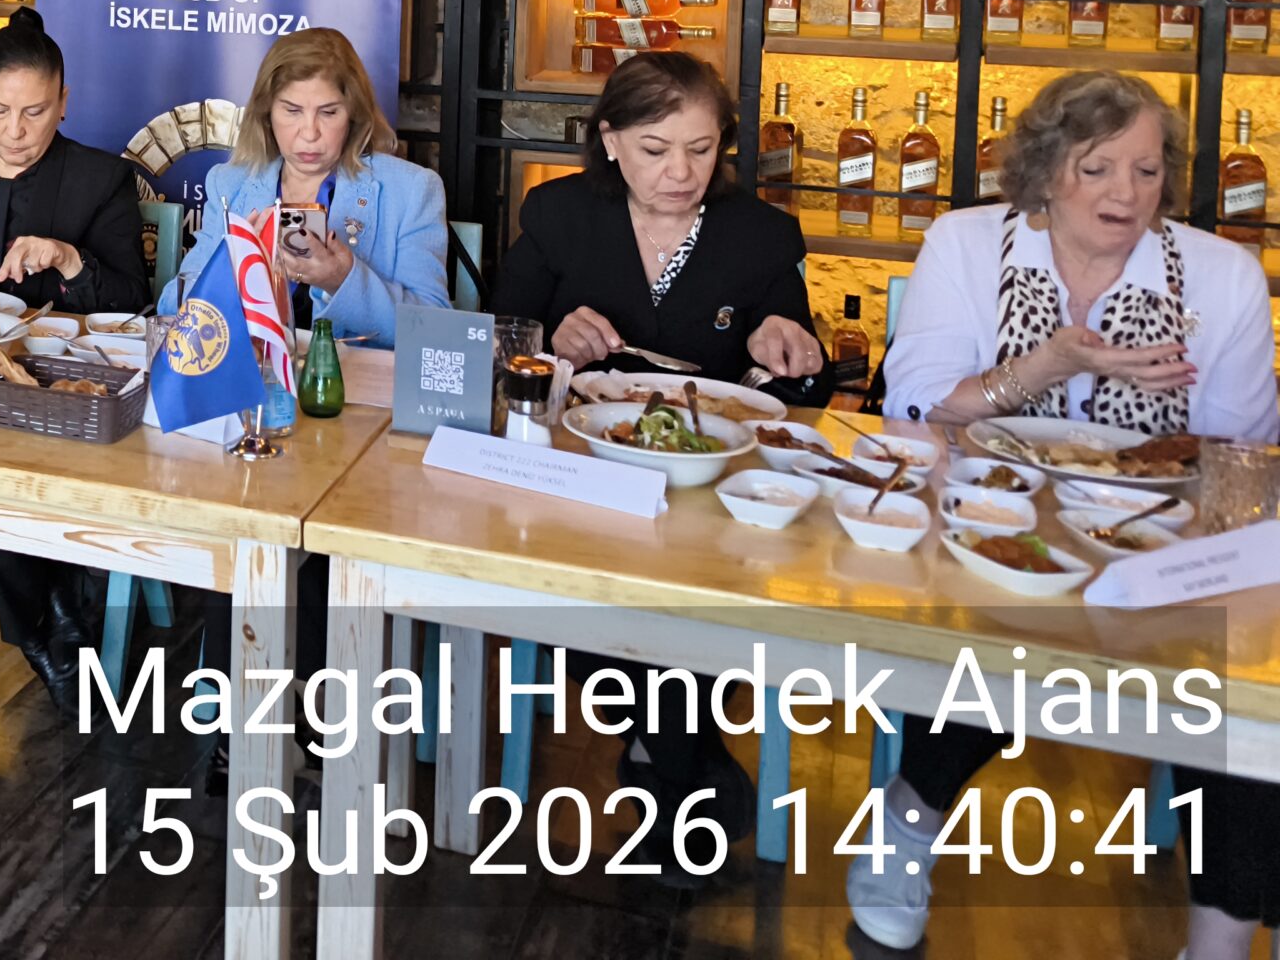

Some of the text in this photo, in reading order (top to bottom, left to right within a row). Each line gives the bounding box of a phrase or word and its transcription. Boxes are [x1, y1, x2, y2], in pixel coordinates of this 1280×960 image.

[109, 0, 312, 36] İSKELE MİMOZA
[190, 304, 214, 320] Othello
[467, 327, 488, 342] 56
